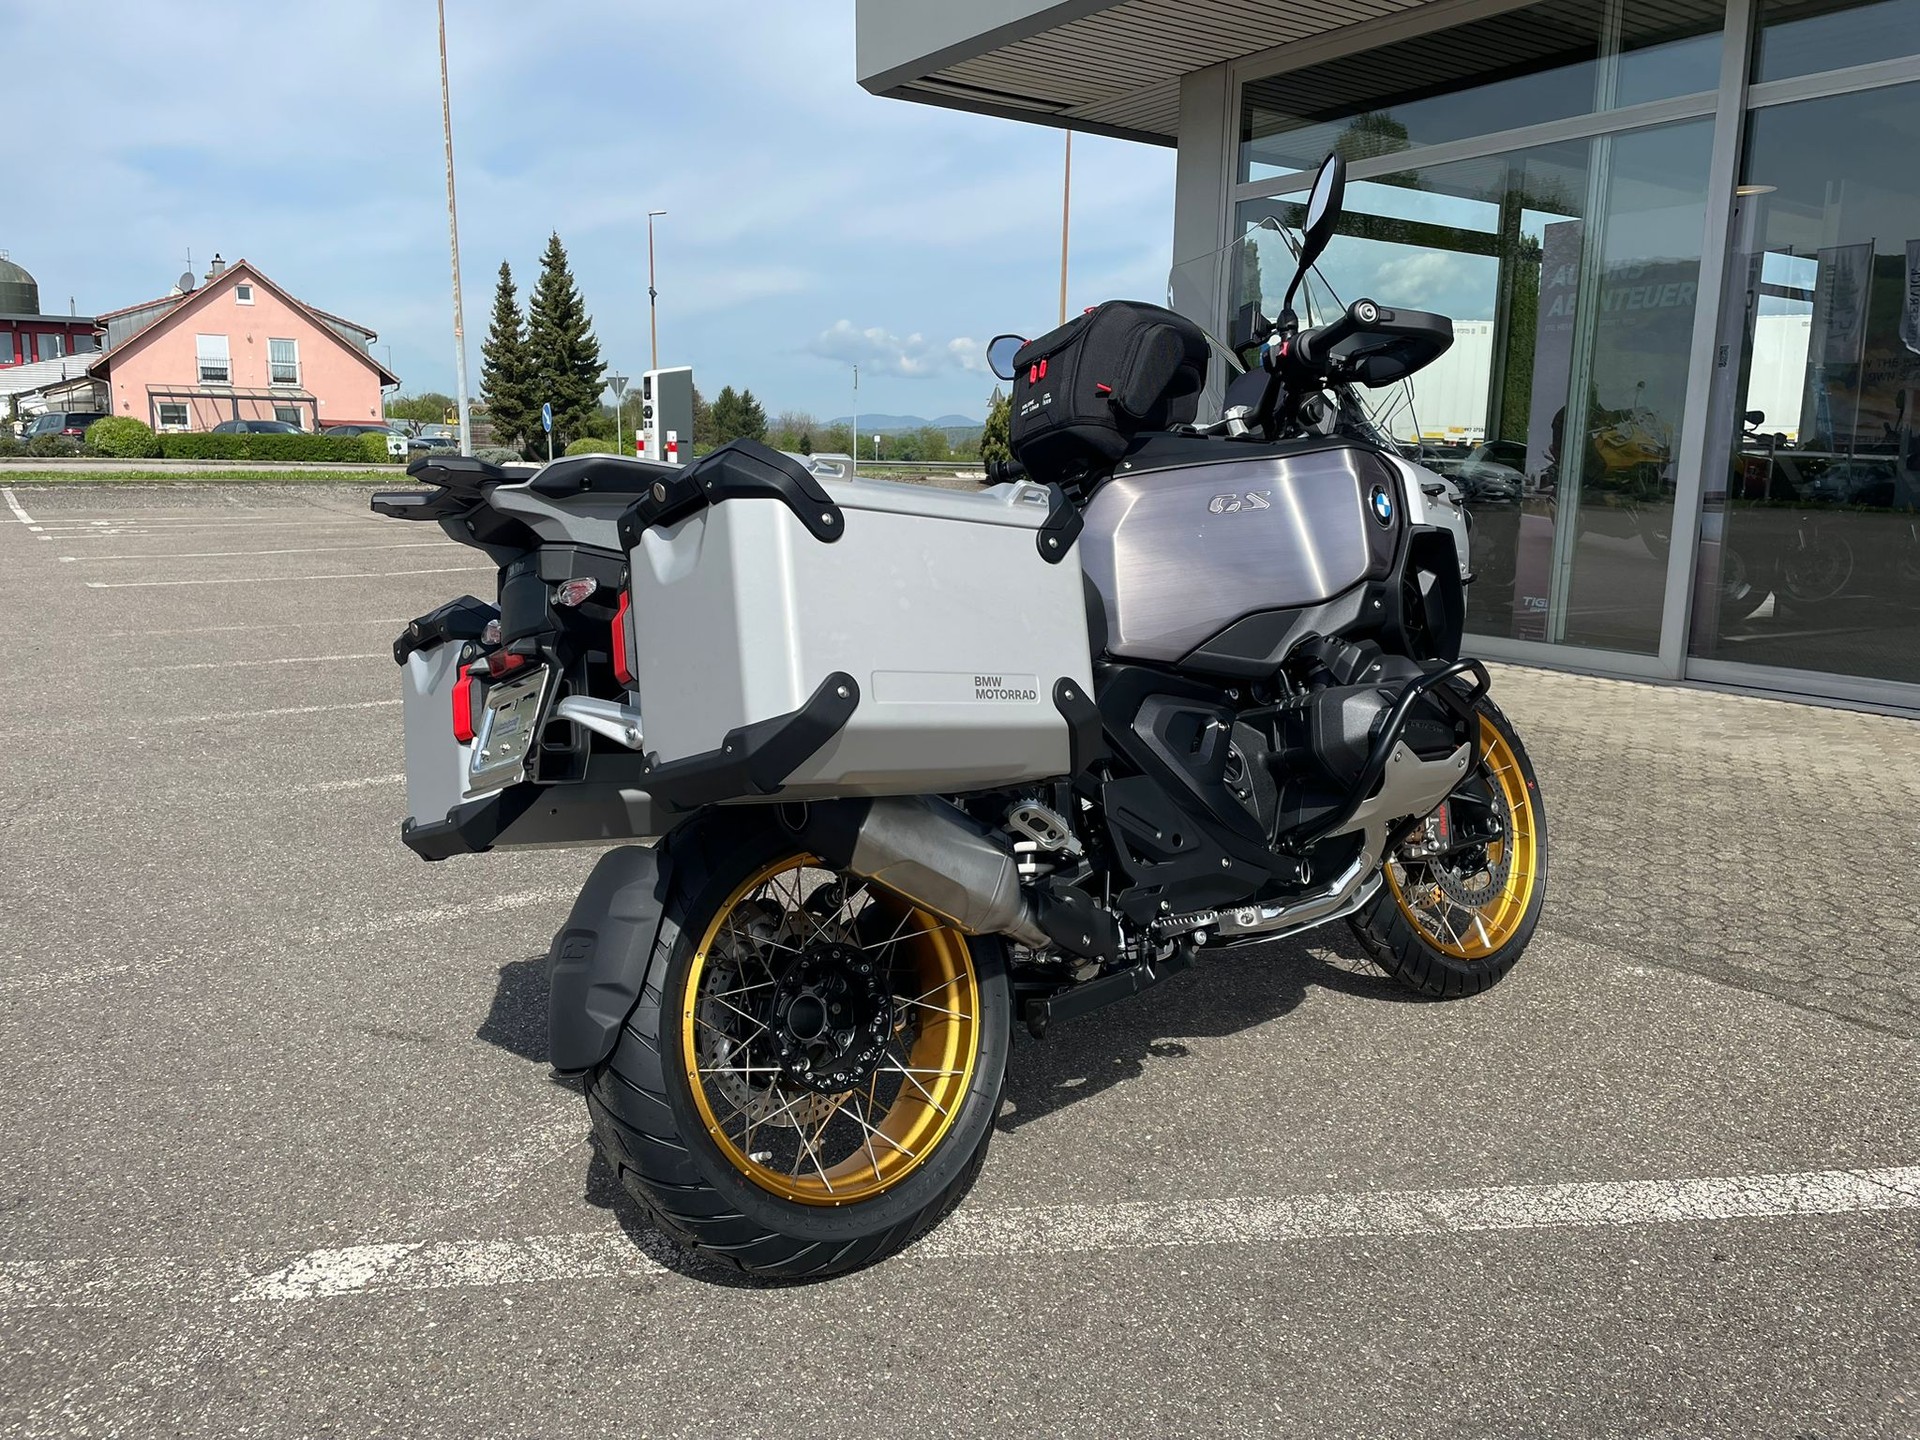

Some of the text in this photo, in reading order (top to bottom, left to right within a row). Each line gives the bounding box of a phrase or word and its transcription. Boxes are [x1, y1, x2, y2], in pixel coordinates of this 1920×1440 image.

[1208, 490, 1272, 515] GS
[1522, 596, 1548, 608] TIG
[974, 676, 1002, 687] BMW
[975, 689, 1037, 700] MOTORRAD
